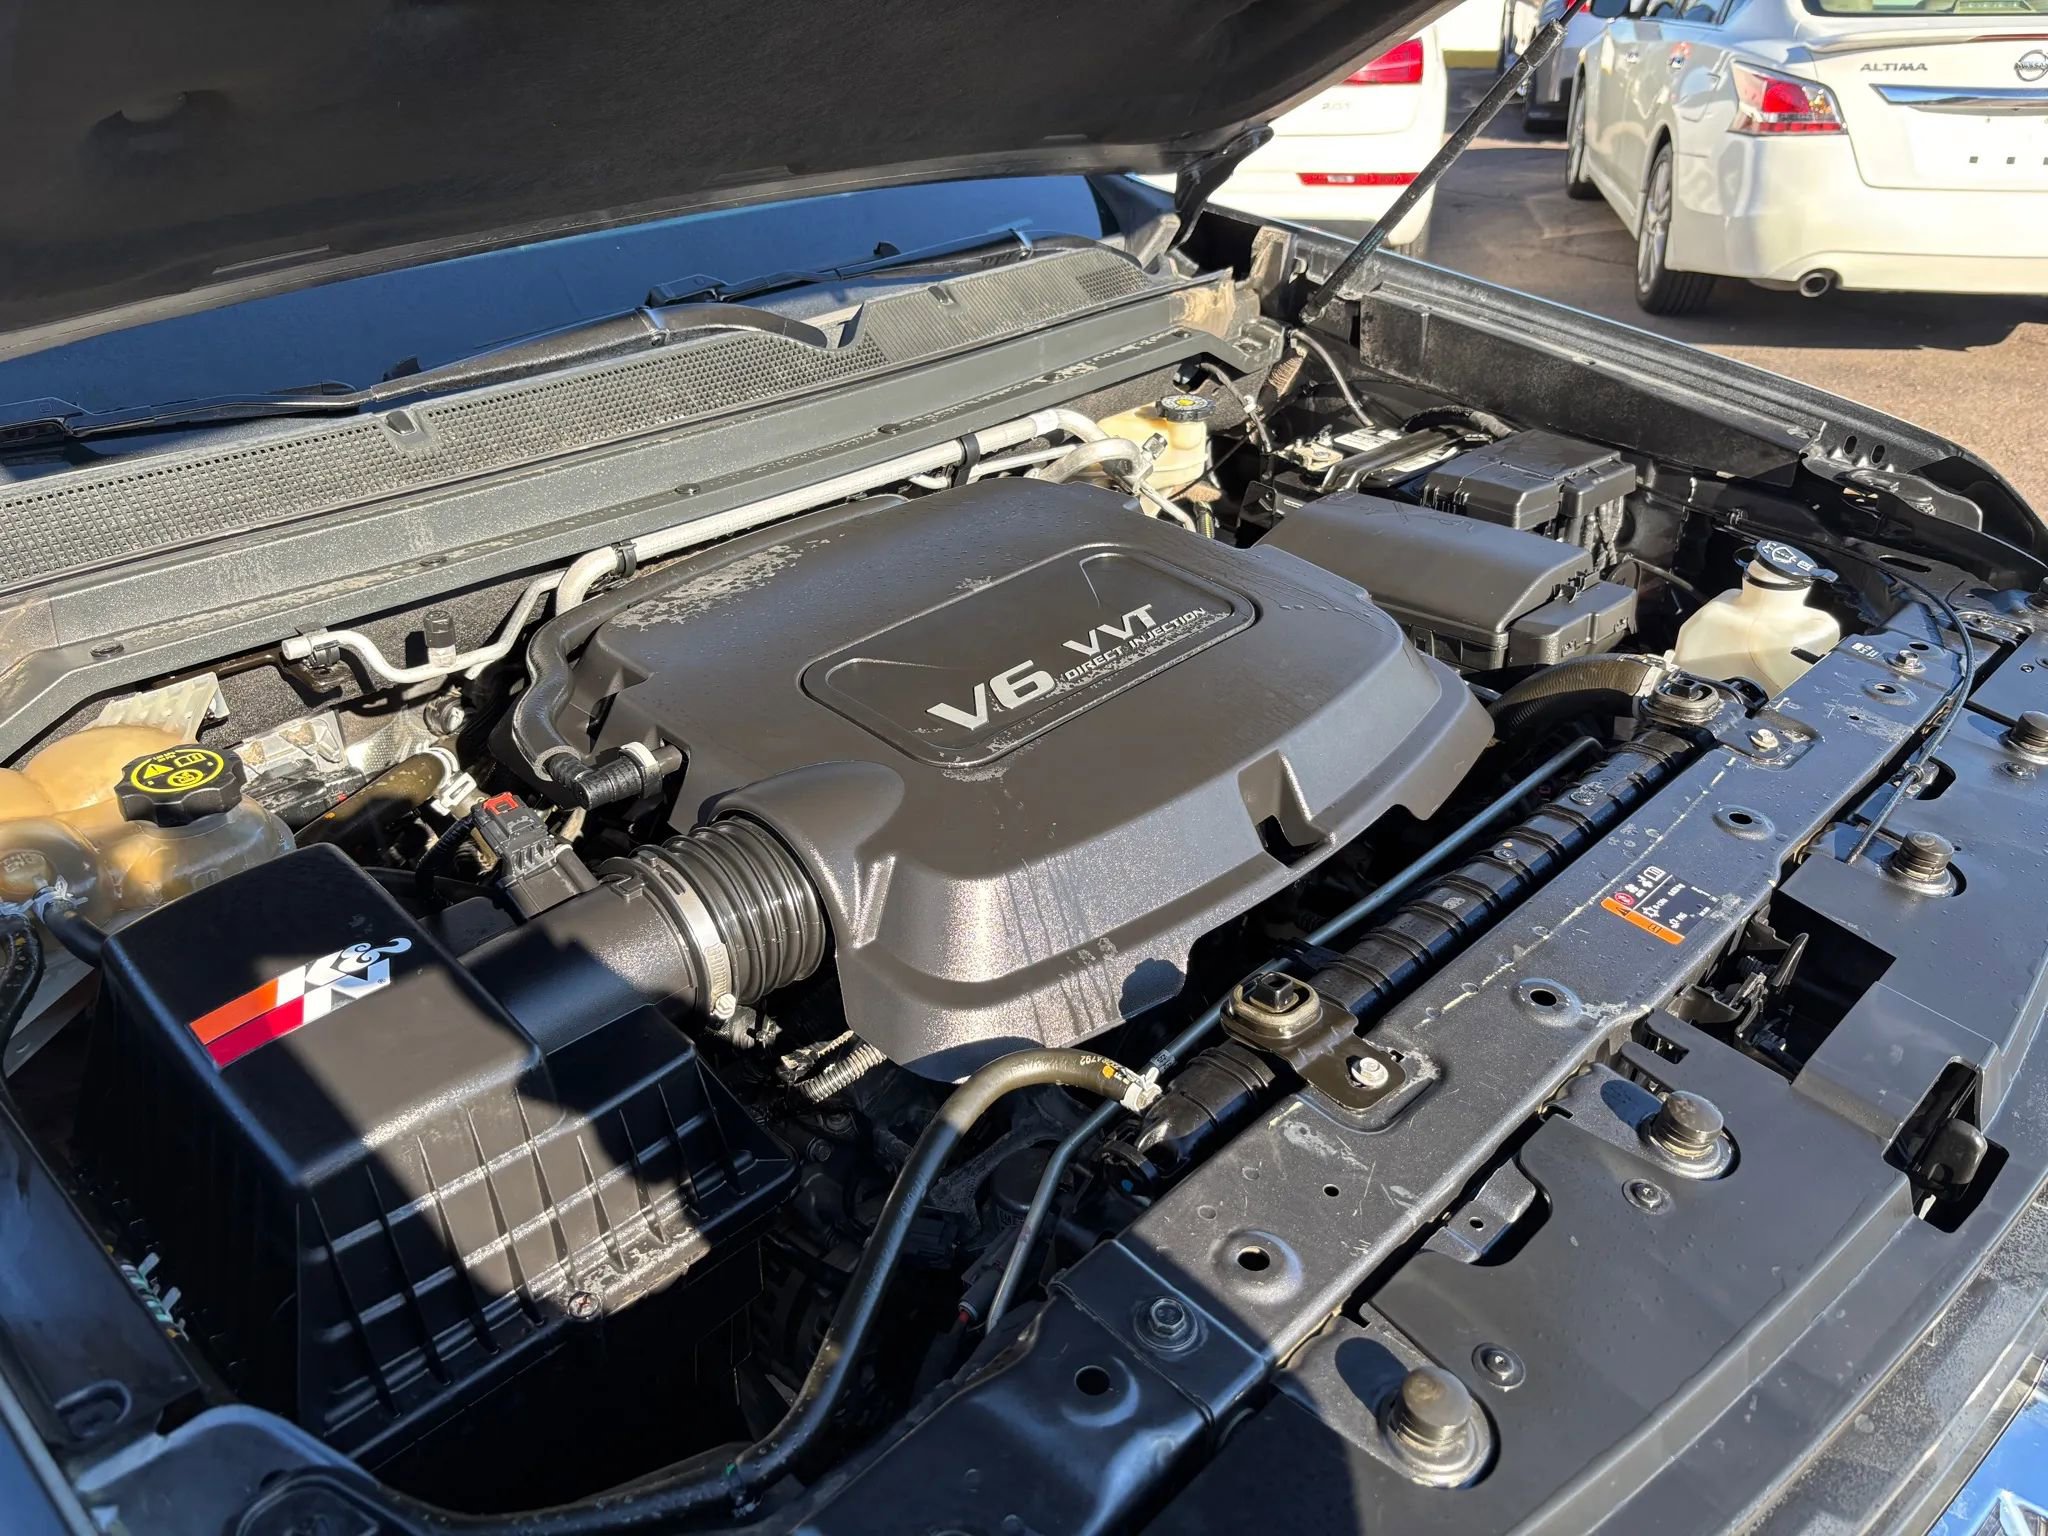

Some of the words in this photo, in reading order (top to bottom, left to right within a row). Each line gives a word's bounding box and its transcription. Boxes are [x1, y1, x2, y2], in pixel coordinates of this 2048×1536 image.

[1860, 62, 1928, 72] ALTIMA
[1062, 603, 1158, 656] VVT
[1064, 645, 1123, 682] DIRECT
[1128, 607, 1206, 648] INJECTION
[925, 659, 1056, 730] V6
[278, 937, 412, 1025] K&N
